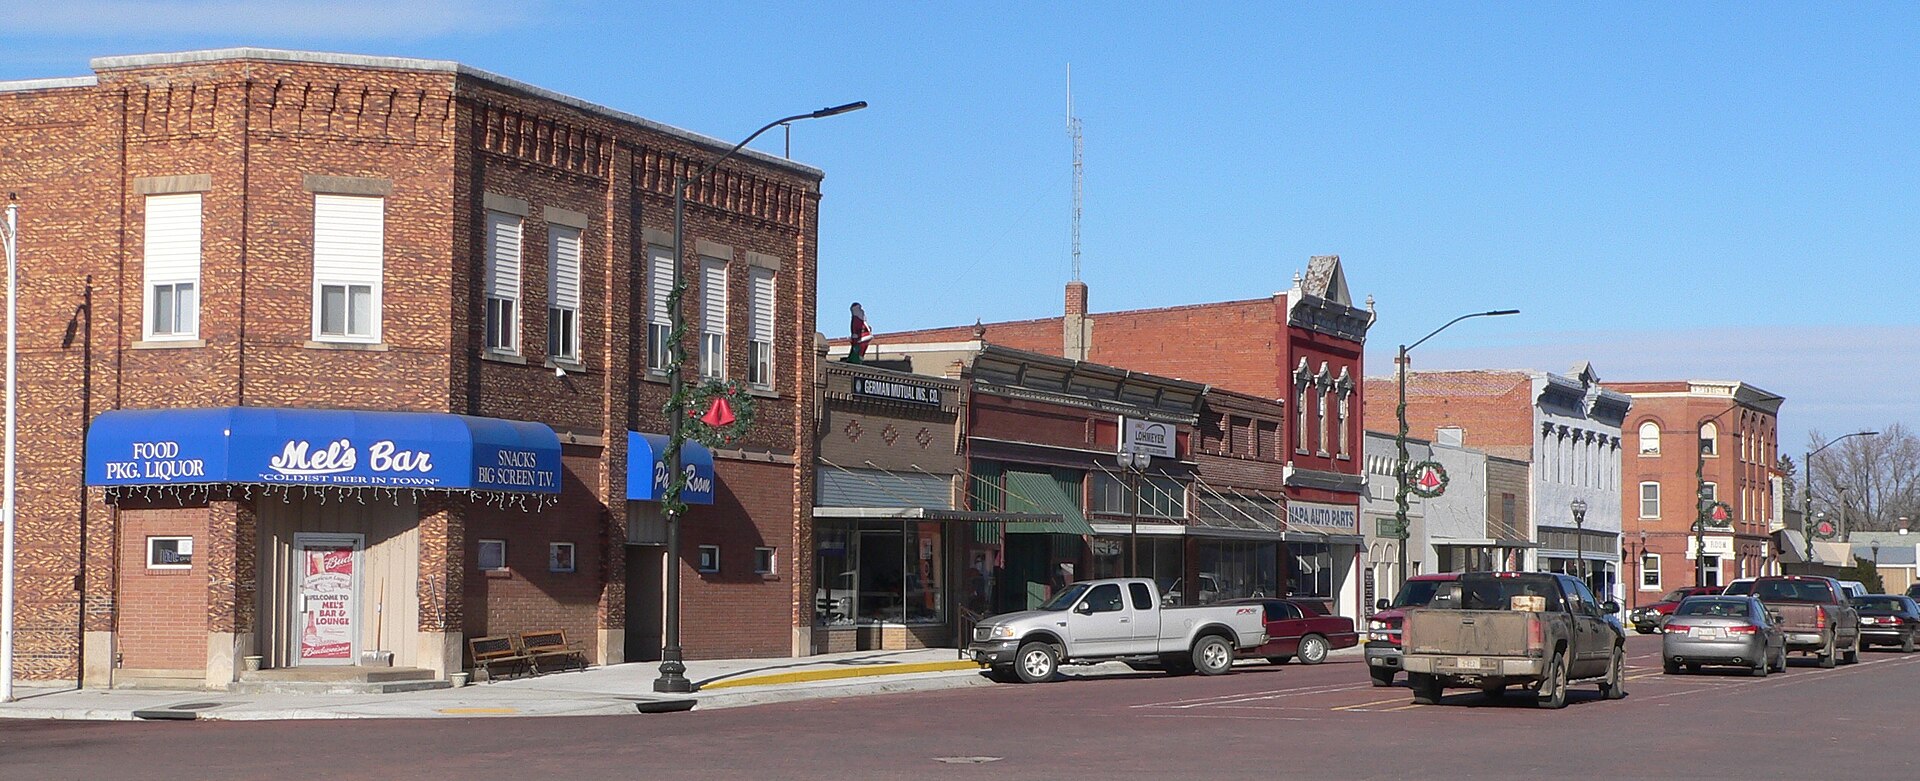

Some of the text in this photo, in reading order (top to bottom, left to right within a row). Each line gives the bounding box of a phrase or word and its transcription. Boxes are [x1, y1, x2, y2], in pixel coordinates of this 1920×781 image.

[864, 379, 890, 396] GERMAN
[891, 383, 914, 399] MUTUAL
[1135, 430, 1165, 444] LOHMEYER
[132, 441, 179, 460] FOOD
[271, 439, 433, 473] Mel's Bar
[498, 449, 536, 468] SNACKS
[106, 459, 204, 480] PKG. LIQUOR
[259, 473, 440, 485] "COLDEST BEER IN TOWN"
[478, 466, 555, 487] BIG SCREEN T.V.
[685, 464, 711, 493] Room
[1288, 506, 1354, 528] NAPA AUTO PARTS
[319, 609, 346, 617] BAR &
[322, 601, 344, 609] MEL'S
[315, 617, 350, 625] LOUNGE
